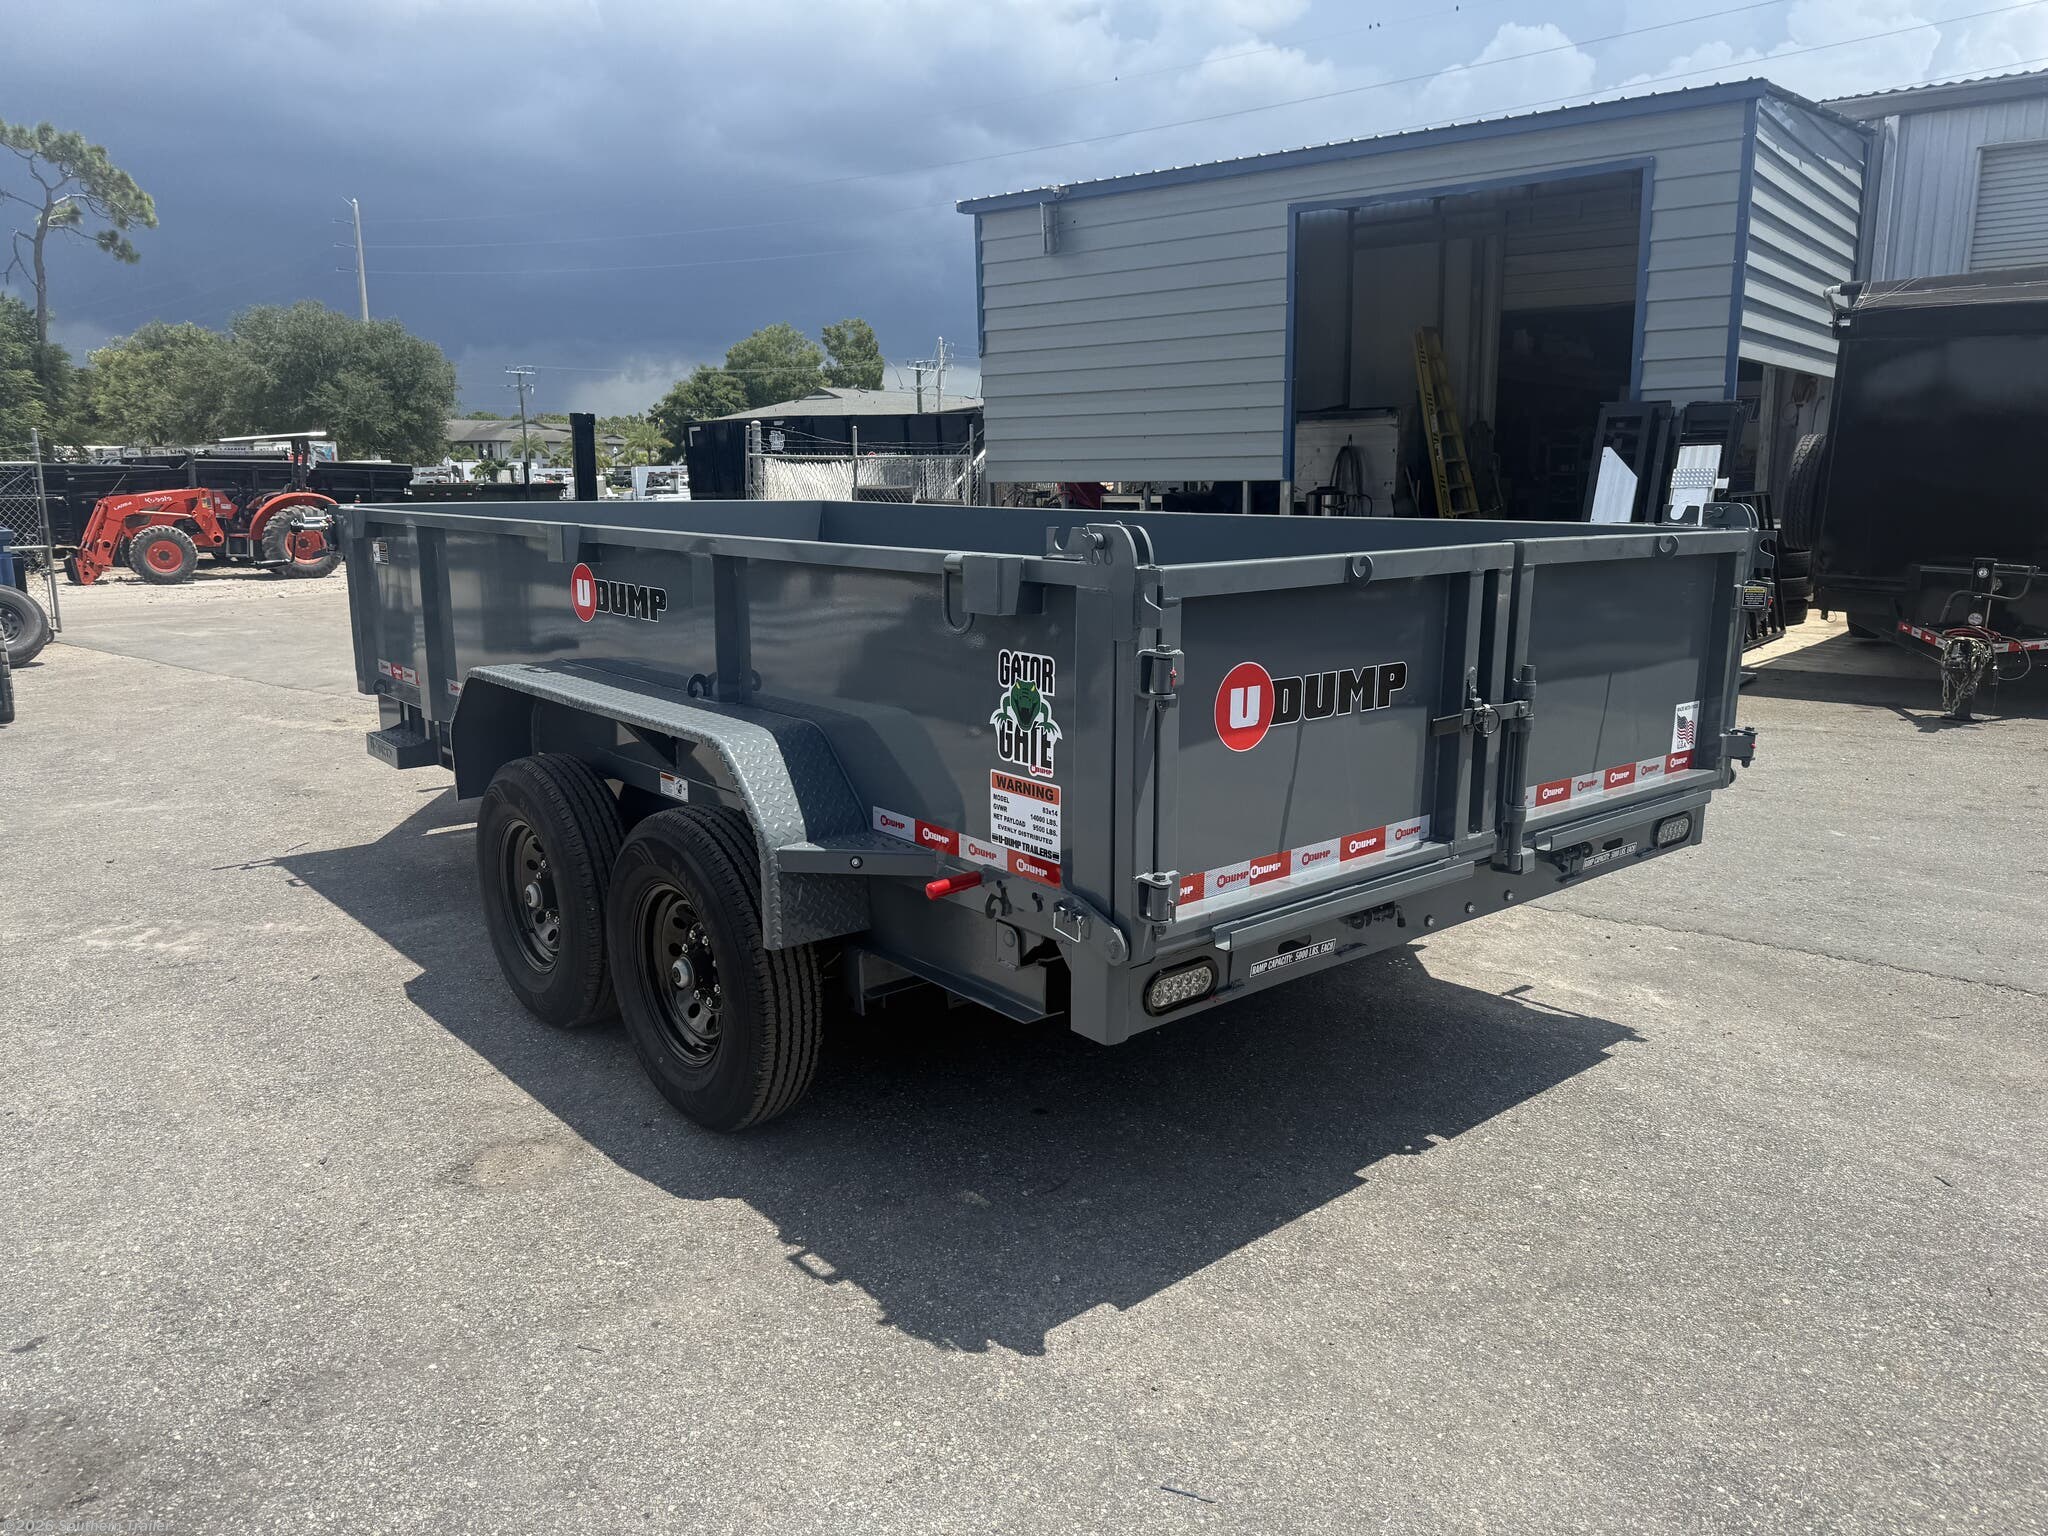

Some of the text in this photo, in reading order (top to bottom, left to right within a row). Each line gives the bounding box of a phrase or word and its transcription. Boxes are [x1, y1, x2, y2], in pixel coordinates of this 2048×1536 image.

[999, 651, 1054, 696] GATOR
[993, 793, 1010, 804] MODEL
[996, 775, 1054, 801] WARNING
[993, 803, 1058, 827] GVWR 14000 LBS.
[993, 812, 1058, 837] NET PAYLOAD 9500 LBS.
[997, 823, 1053, 845] EVENLY DISTRIBUTED
[999, 834, 1053, 860] U-DUMP TRAILERS
[1252, 962, 1267, 975] RAMP
[1295, 949, 1308, 961] 5000
[1320, 941, 1334, 953] EACH
